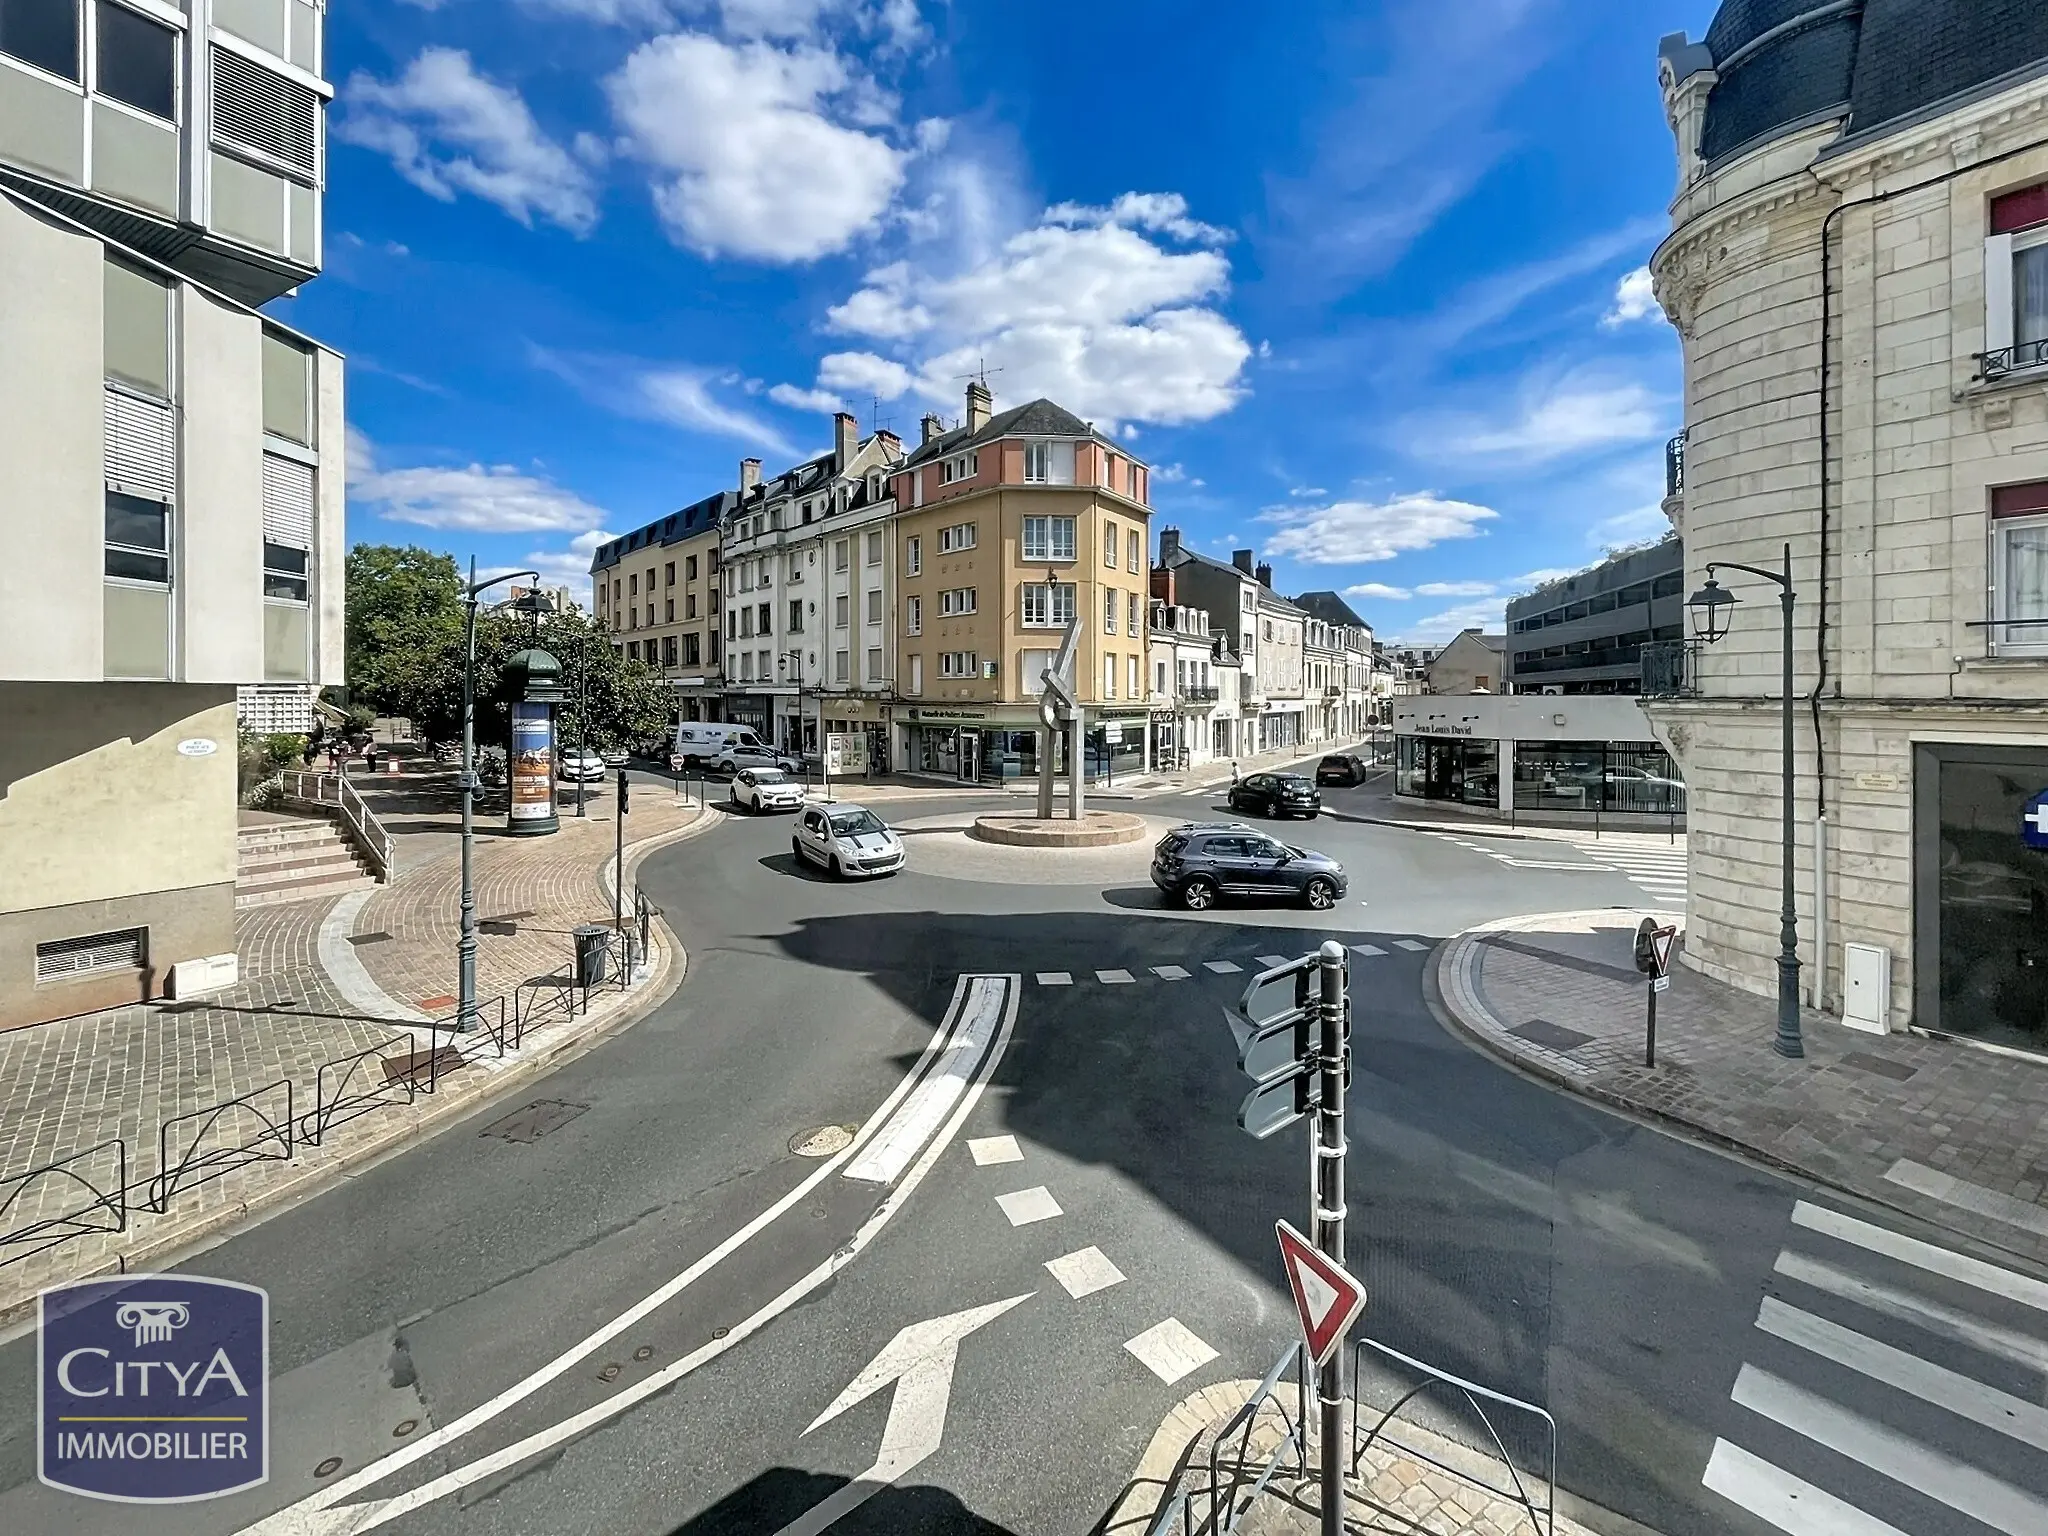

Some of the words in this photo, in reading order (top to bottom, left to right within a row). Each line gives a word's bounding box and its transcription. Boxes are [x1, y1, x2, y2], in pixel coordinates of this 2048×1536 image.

[1415, 723, 1430, 733] Jean
[1431, 723, 1450, 734] Louis
[1451, 724, 1472, 735] David
